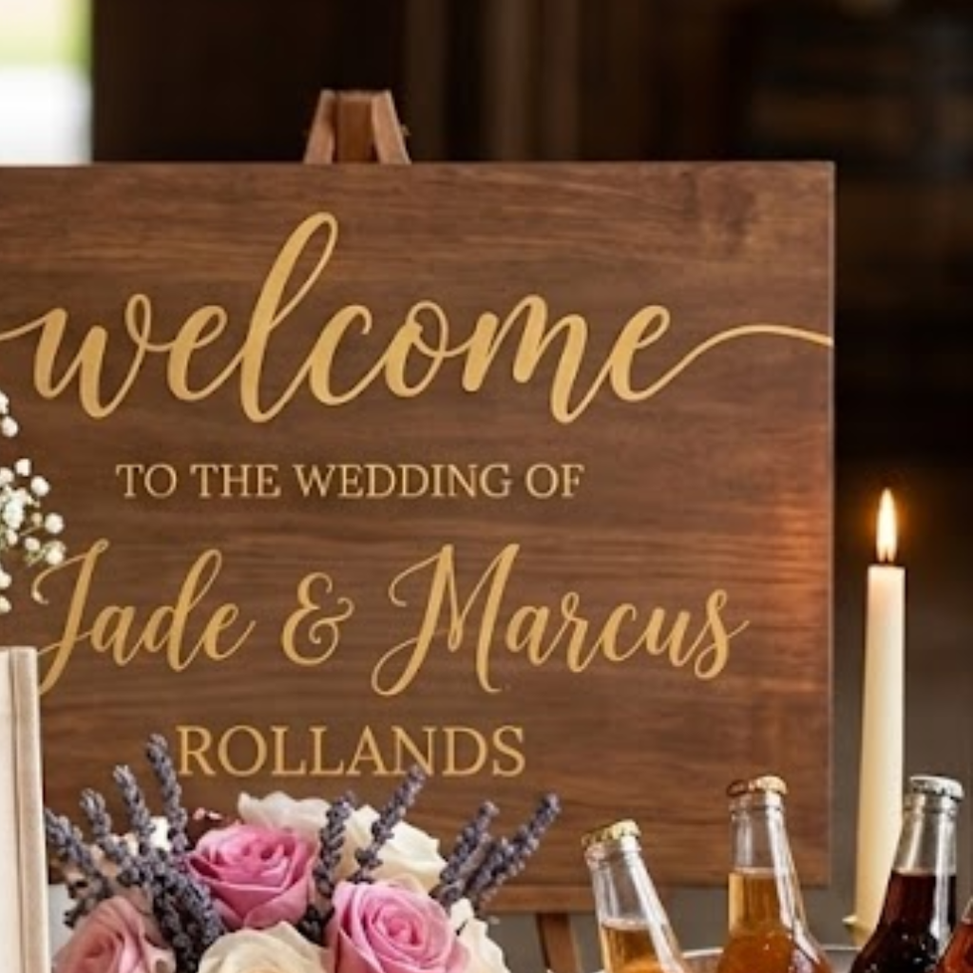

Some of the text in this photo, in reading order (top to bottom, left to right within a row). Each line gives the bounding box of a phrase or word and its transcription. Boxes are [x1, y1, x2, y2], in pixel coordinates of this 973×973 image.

[116, 463, 585, 500] TO THE WEDDING OF
[31, 538, 749, 697] Jade & Marcus
[176, 723, 526, 778] ROLLANDS
